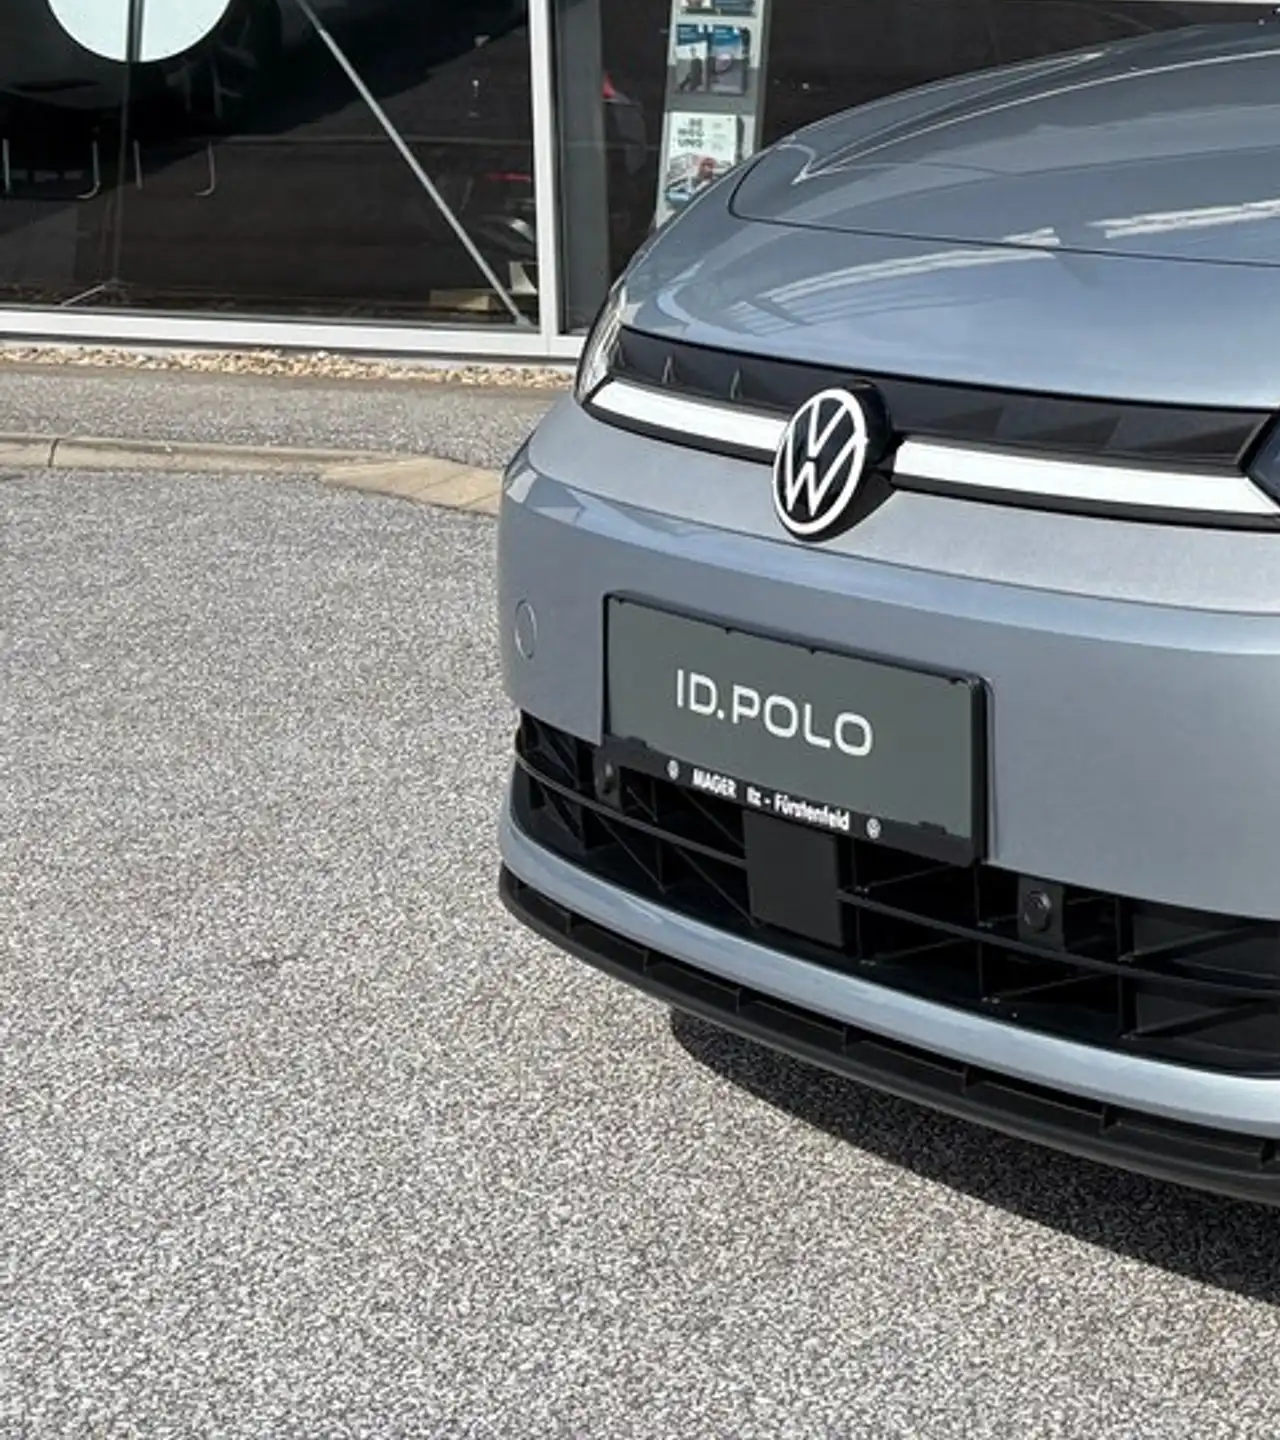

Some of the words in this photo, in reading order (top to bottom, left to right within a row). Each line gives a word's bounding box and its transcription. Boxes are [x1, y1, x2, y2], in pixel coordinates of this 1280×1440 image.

[676, 668, 874, 757] ID.POLO
[692, 767, 738, 800] MAGER
[773, 792, 850, 832] Fürstenfeld
